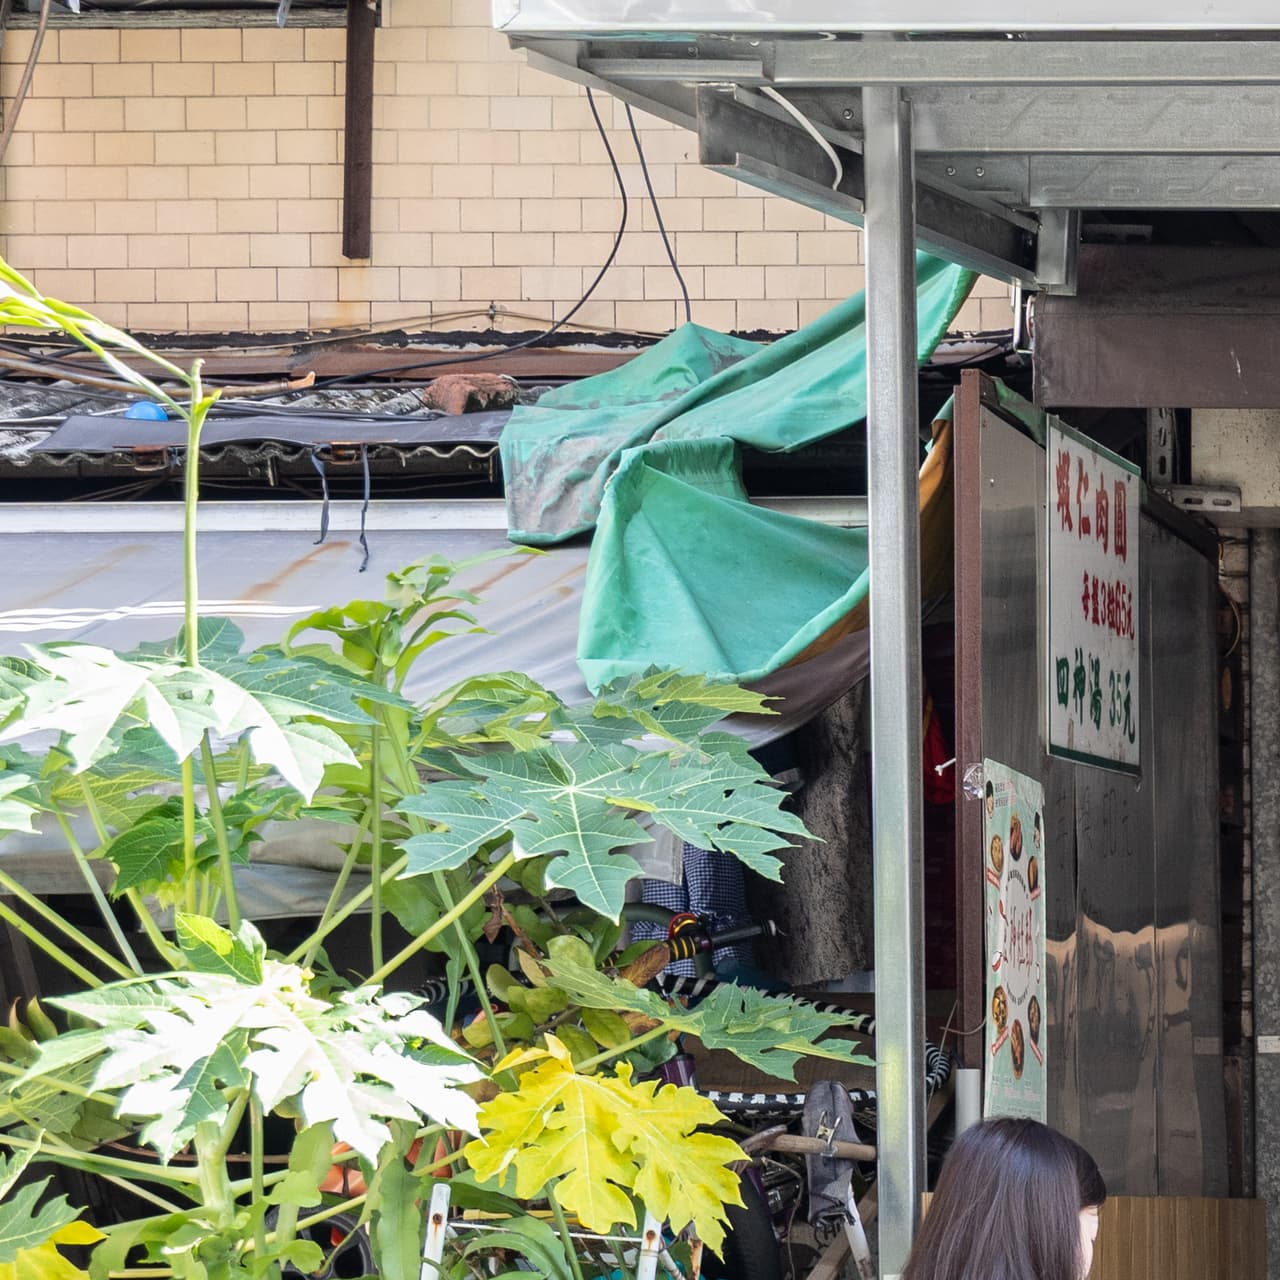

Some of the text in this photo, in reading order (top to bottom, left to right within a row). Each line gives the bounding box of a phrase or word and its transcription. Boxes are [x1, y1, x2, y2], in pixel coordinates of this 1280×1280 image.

[1056, 449, 1127, 564] 蝦仁肉圓
[1056, 648, 1136, 744] 四神湯 35元
